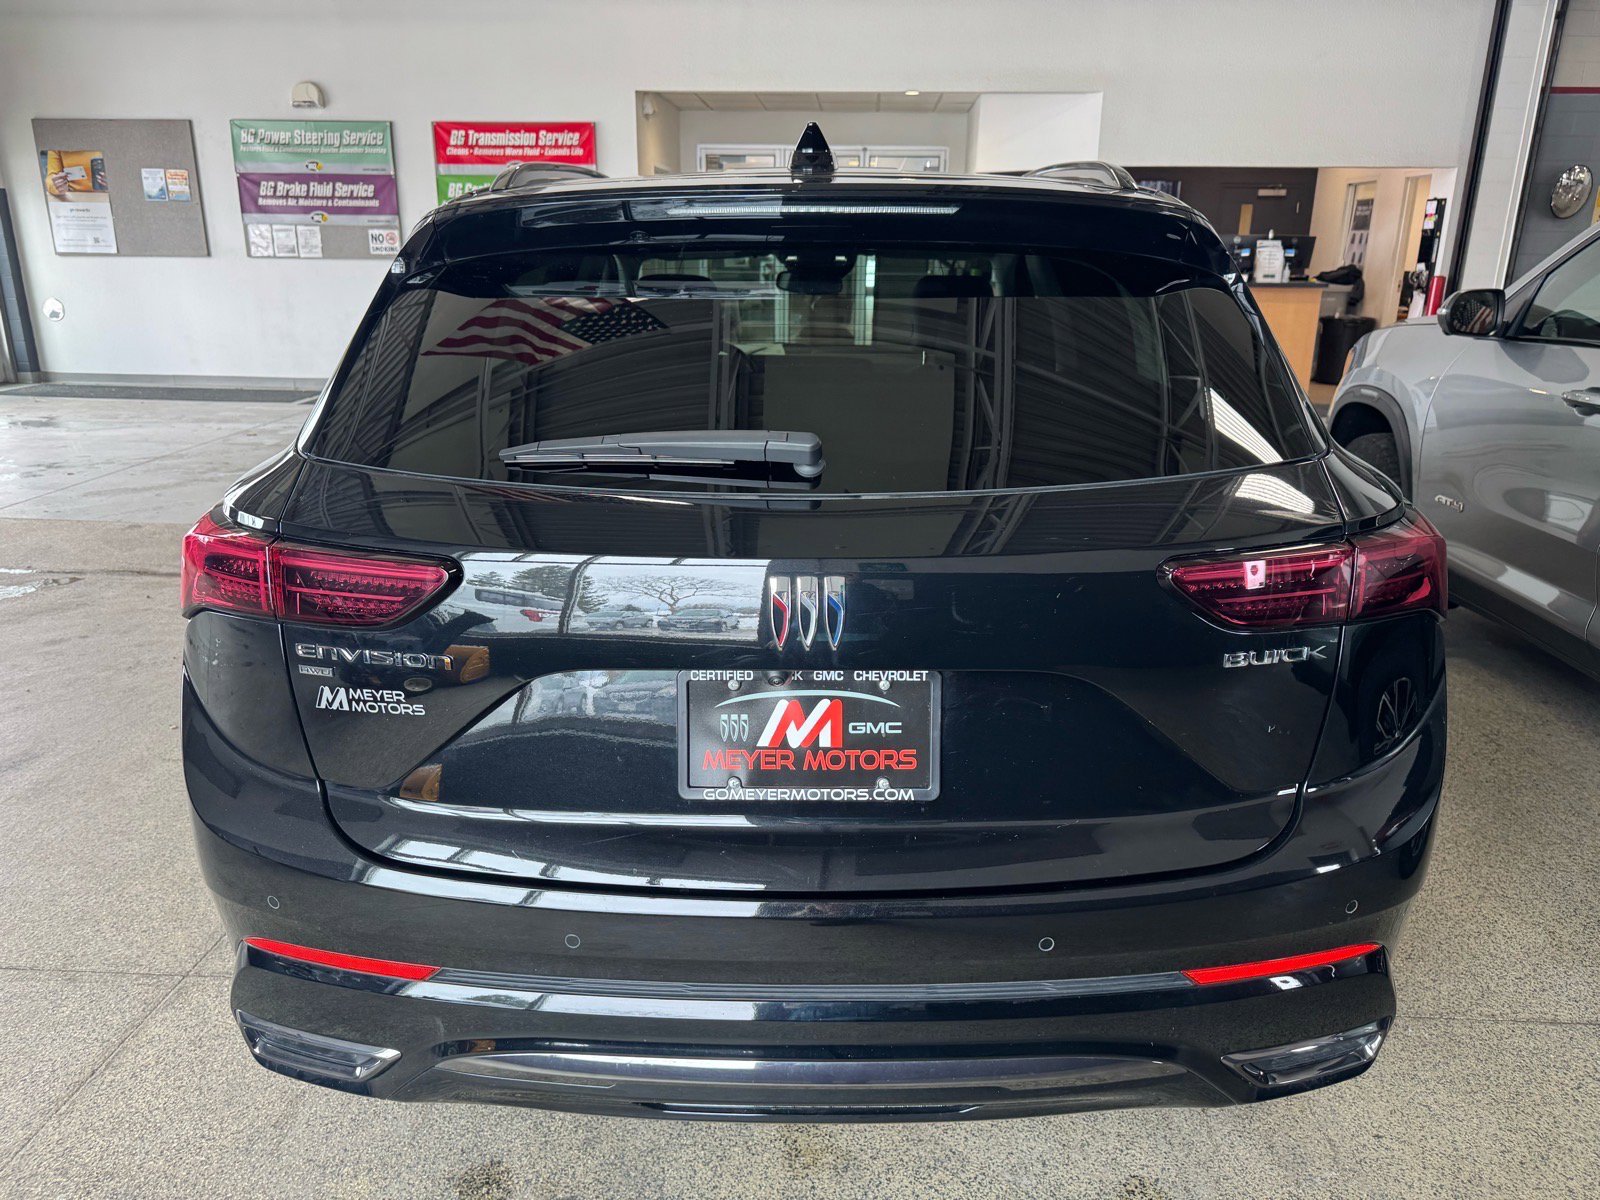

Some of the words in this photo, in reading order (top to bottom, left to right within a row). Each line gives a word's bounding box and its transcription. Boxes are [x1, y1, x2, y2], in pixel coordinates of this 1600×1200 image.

[240, 128, 255, 144] BG
[257, 129, 291, 145] Power
[294, 130, 341, 147] Steering
[342, 130, 384, 146] Service
[450, 130, 465, 145] BG
[468, 130, 536, 146] Transmission
[538, 130, 580, 146] Service
[260, 181, 272, 196] BG
[276, 181, 307, 197] Brake
[309, 182, 333, 197] Fluid
[335, 182, 375, 198] Service
[258, 197, 286, 206] Removes
[333, 199, 380, 207] Contaminants
[371, 233, 384, 243] NO
[295, 642, 454, 671] ENVISION
[1223, 645, 1328, 668] BUICK
[690, 670, 754, 681] CERTIFIED
[813, 670, 844, 681] GMC
[853, 670, 929, 682] CHEVROLET
[349, 688, 406, 703] MEYER
[352, 701, 426, 716] MOTORS
[848, 722, 902, 734] GMC
[702, 749, 796, 770] MEYER
[803, 749, 918, 770] MOTORS
[703, 788, 915, 801] GOMEYERMOTORS.COM
